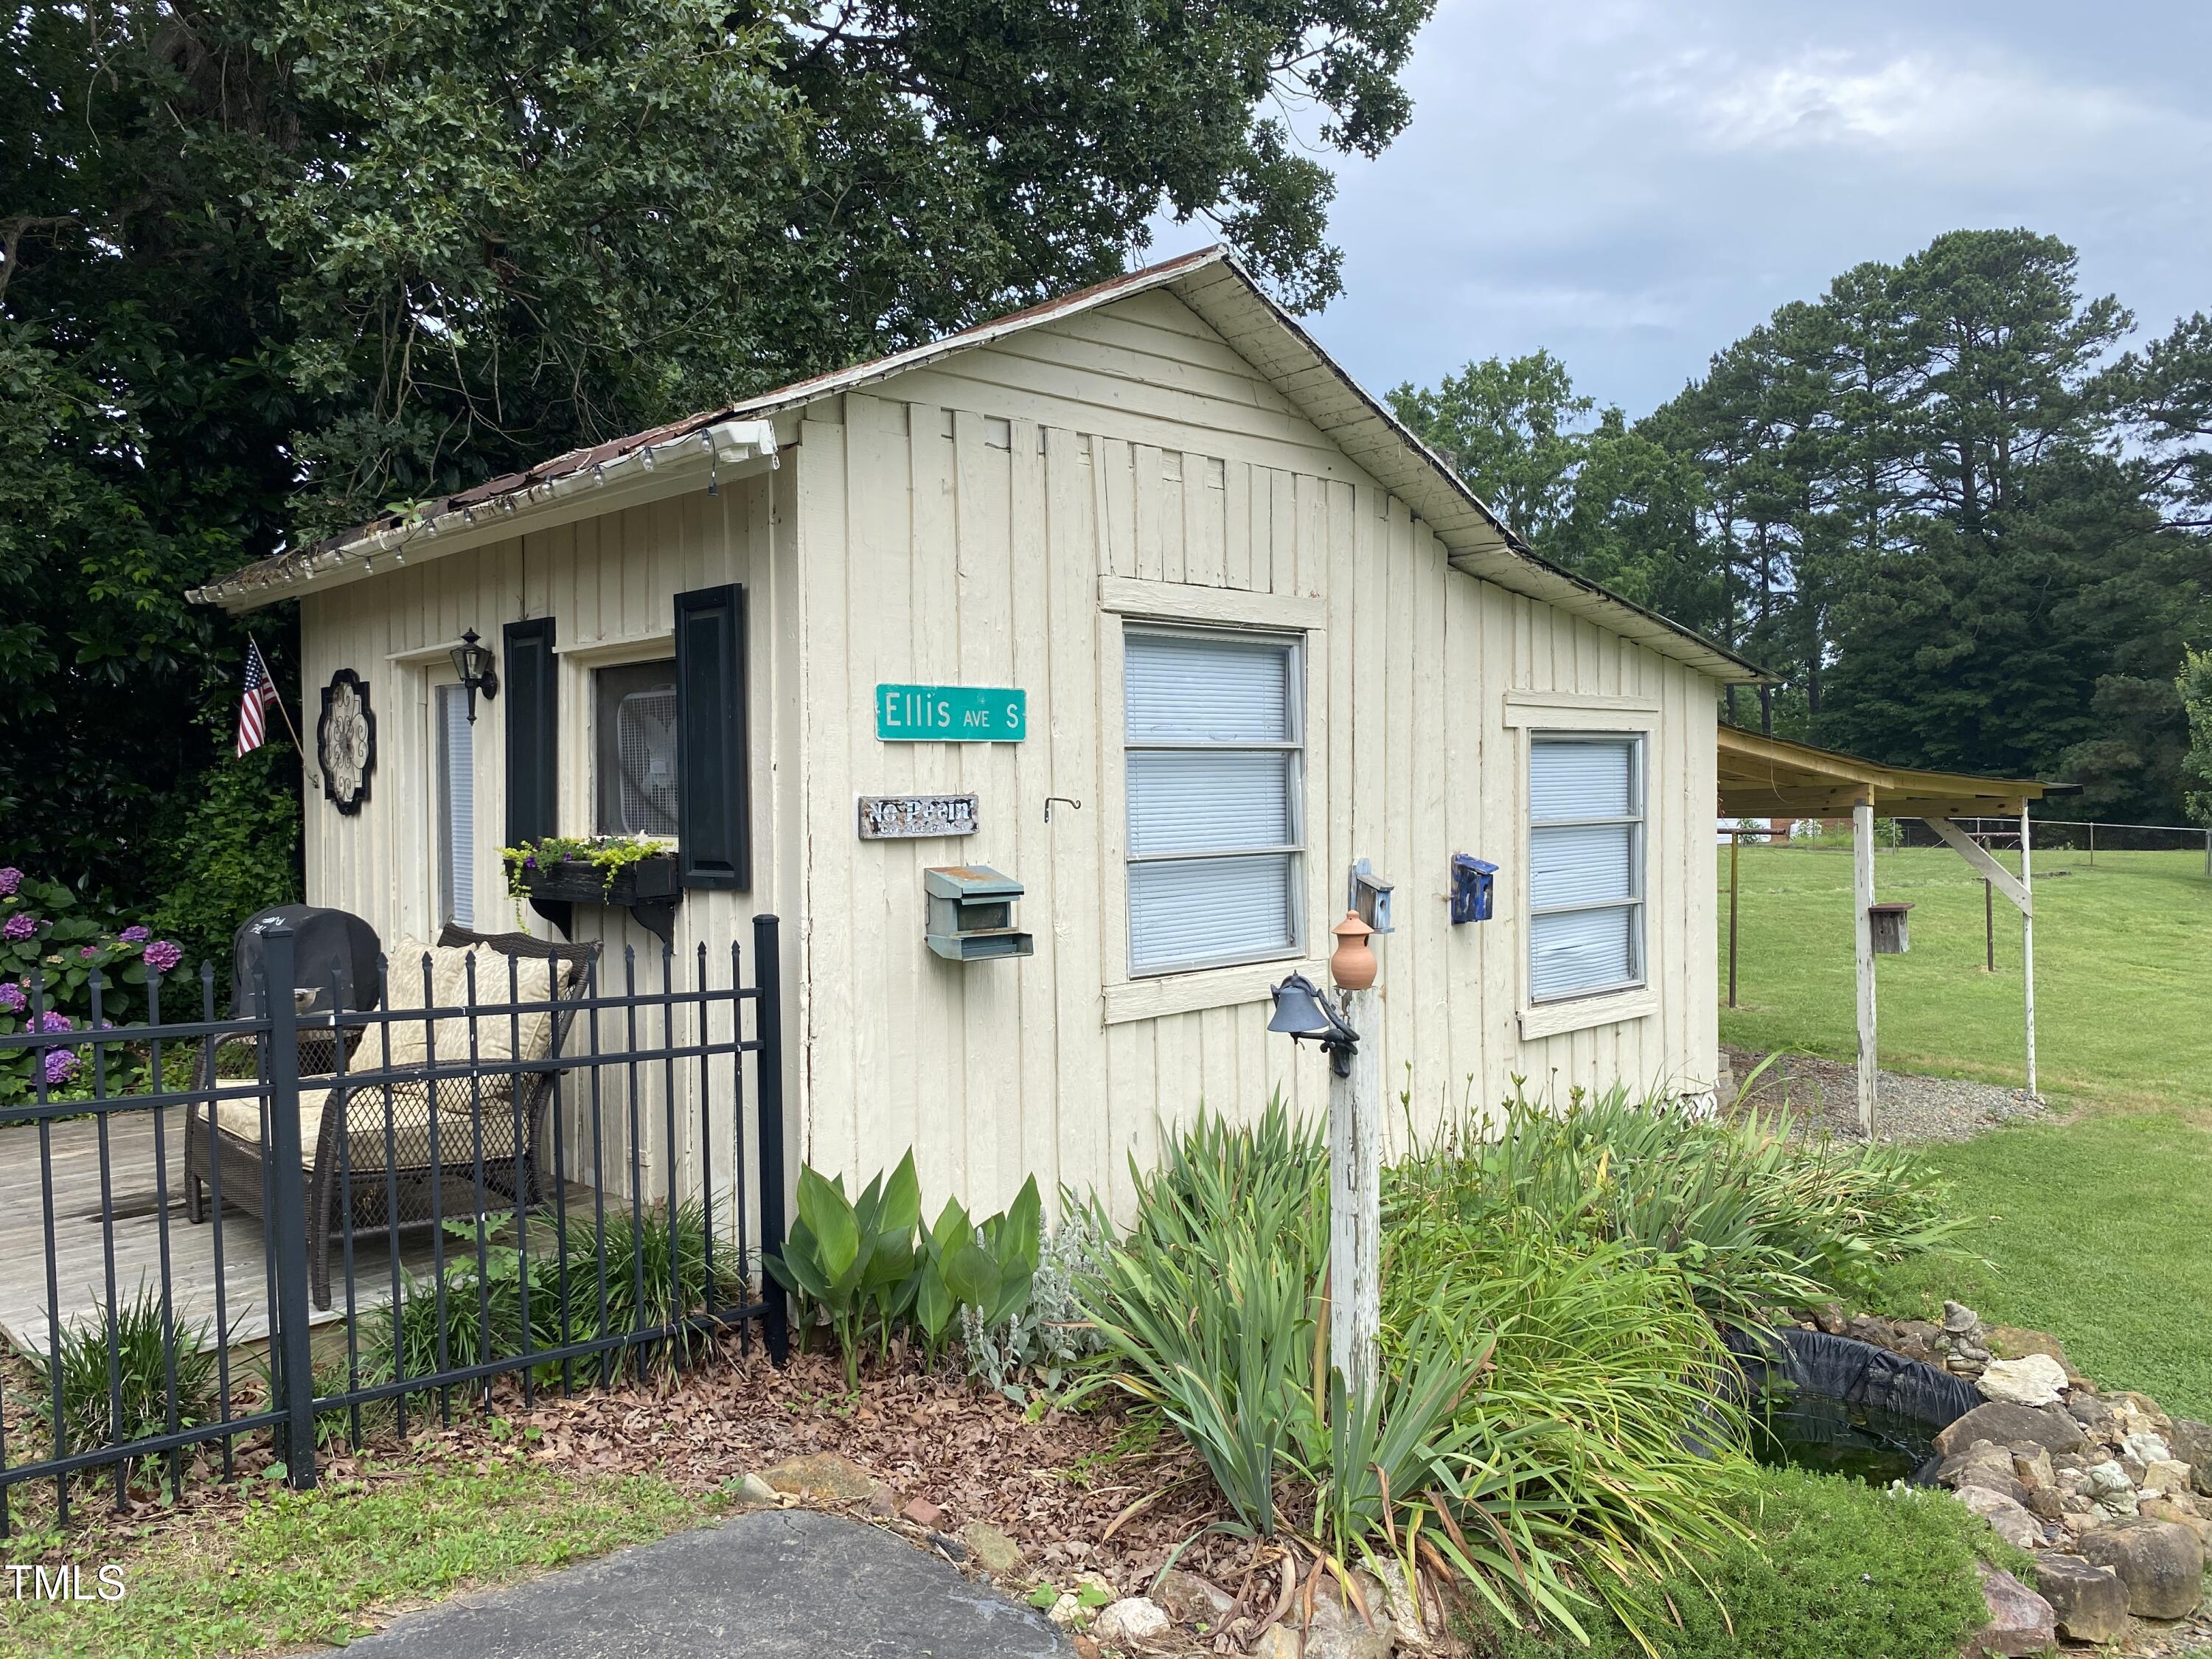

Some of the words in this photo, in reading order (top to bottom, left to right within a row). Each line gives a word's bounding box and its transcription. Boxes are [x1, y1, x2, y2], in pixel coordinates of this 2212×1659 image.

[886, 692, 950, 728] Ellis
[963, 710, 990, 728] AVE
[1006, 703, 1019, 728] S
[869, 801, 898, 823] No
